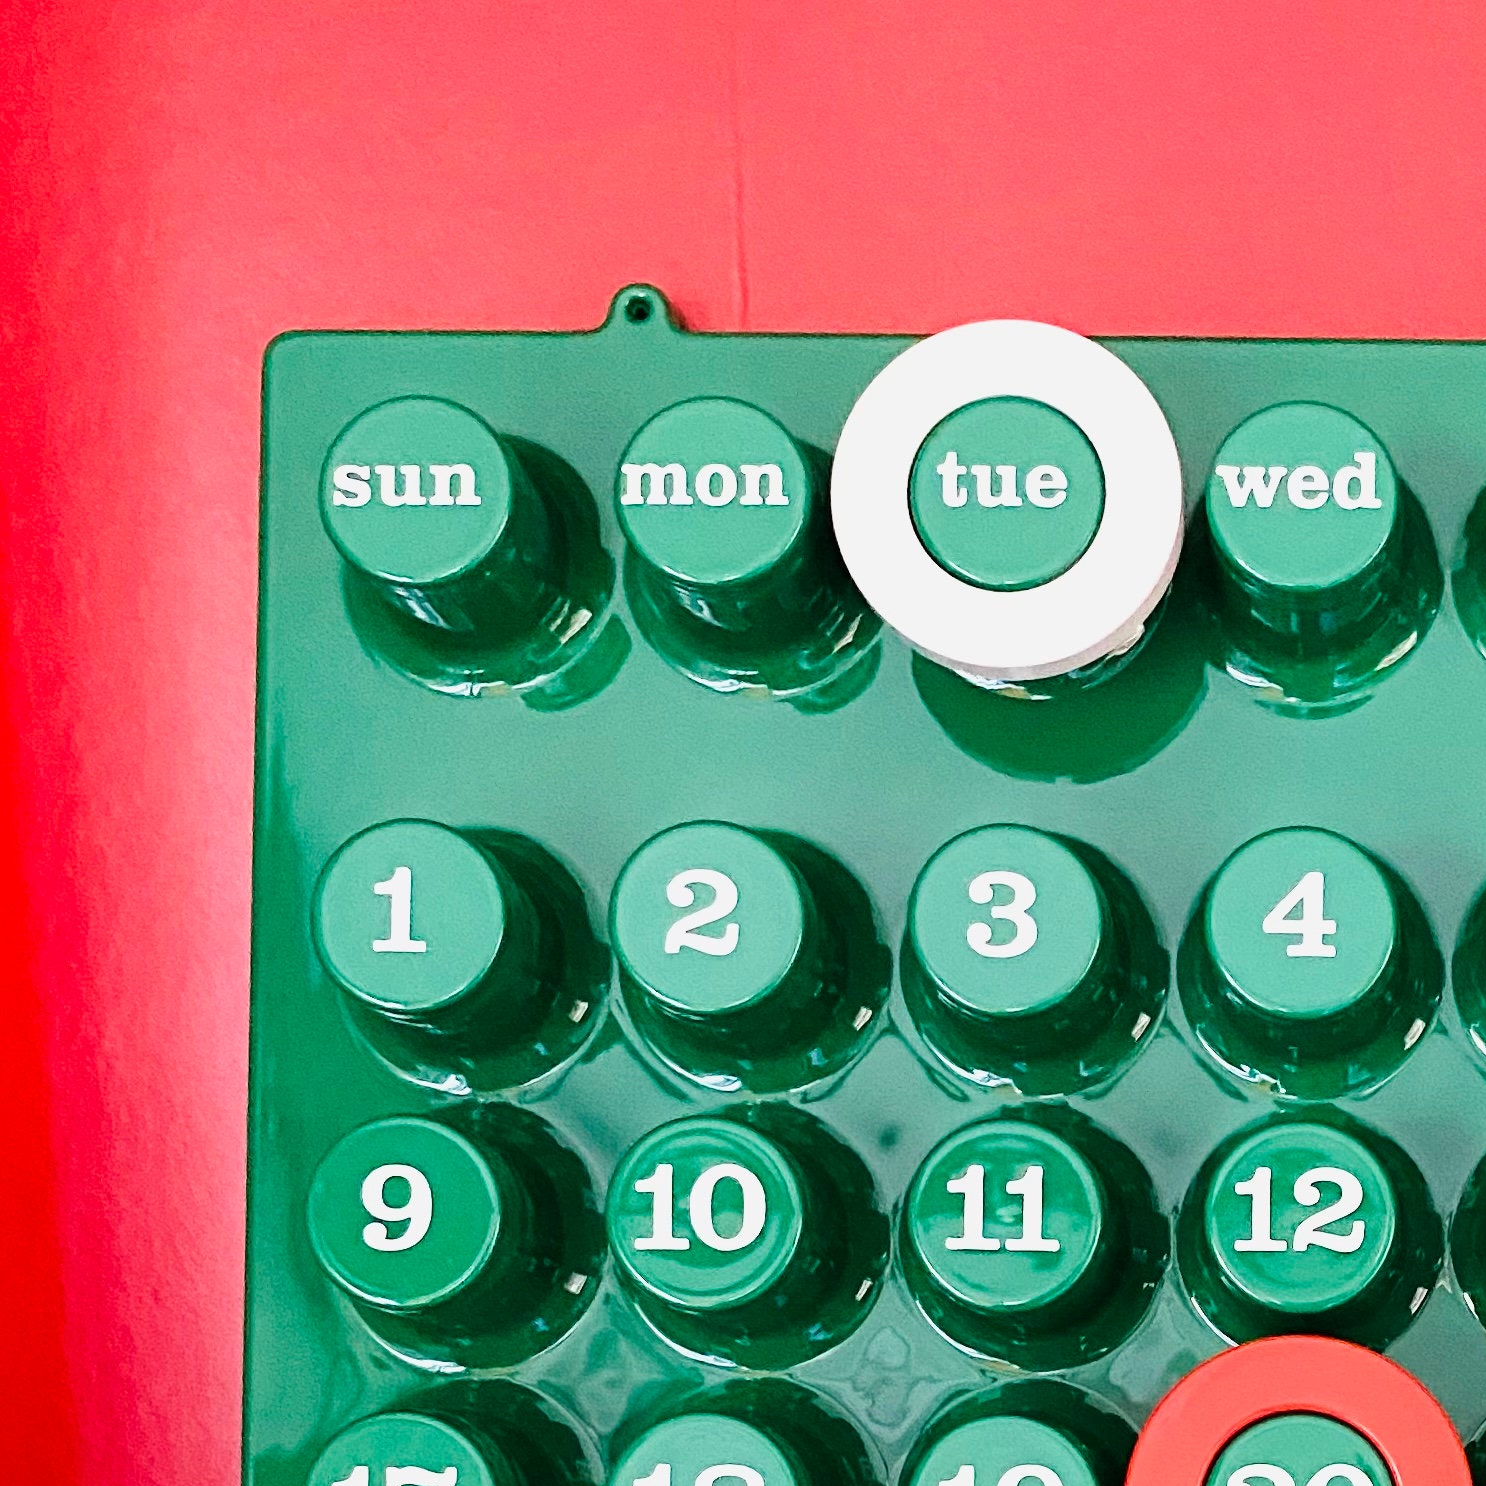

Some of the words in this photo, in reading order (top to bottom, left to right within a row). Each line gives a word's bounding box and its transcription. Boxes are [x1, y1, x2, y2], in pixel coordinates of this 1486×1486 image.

[331, 462, 483, 508] sun
[619, 461, 790, 508] mon
[935, 450, 1069, 509] tue
[1214, 450, 1383, 511] wed
[371, 865, 428, 954] 1
[663, 867, 740, 957] 2
[965, 869, 1039, 959] 3
[1261, 870, 1338, 959] 4
[360, 1163, 434, 1253] 9
[633, 1162, 767, 1252] 10
[944, 1163, 1061, 1253] 11
[1233, 1166, 1366, 1254] 12
